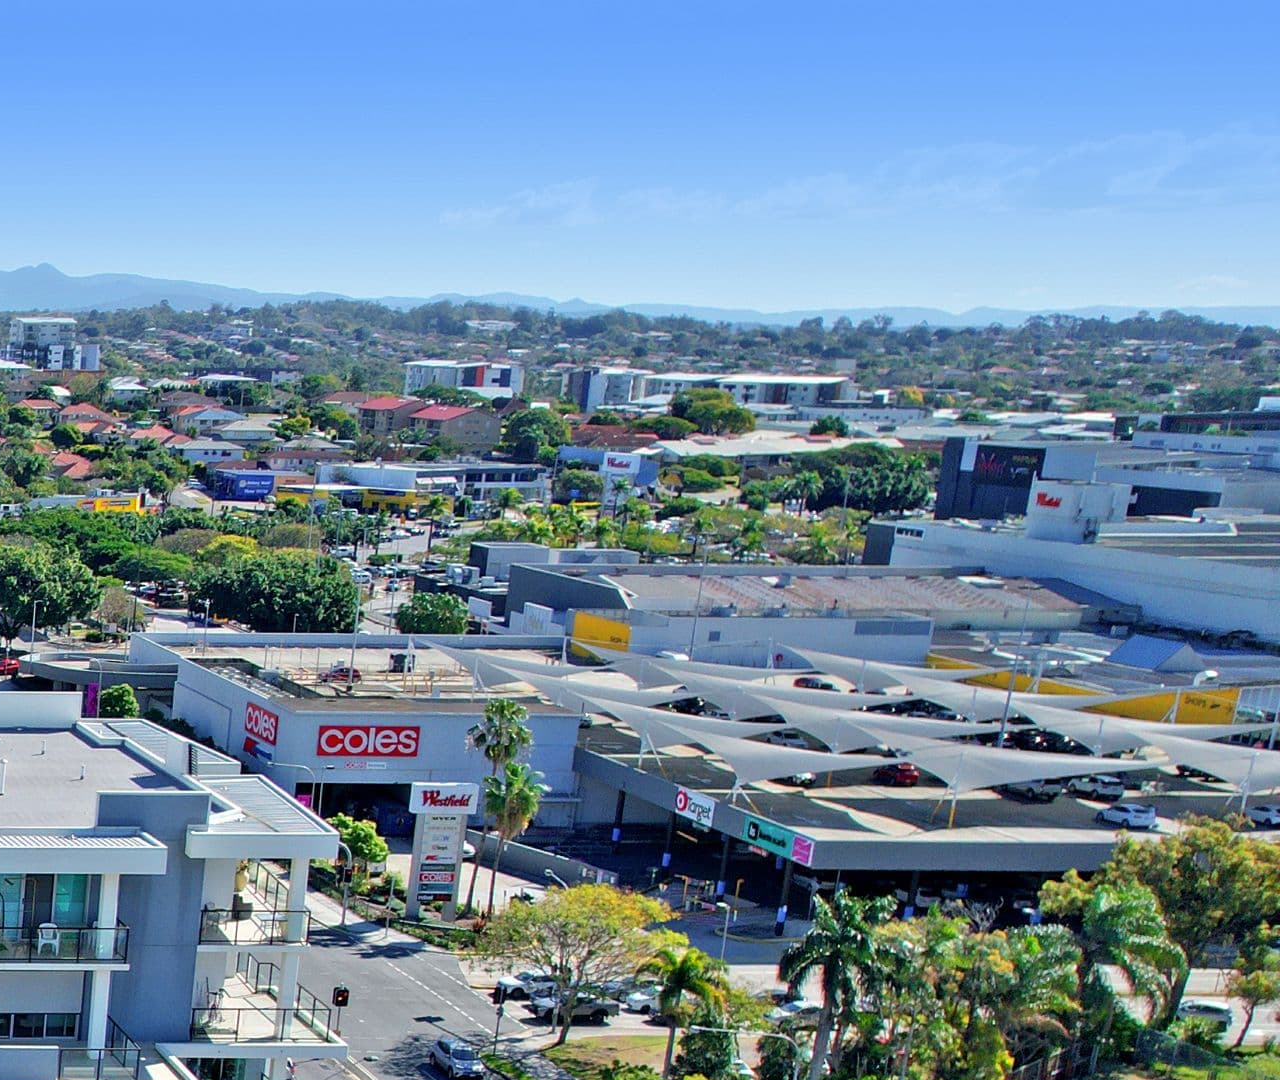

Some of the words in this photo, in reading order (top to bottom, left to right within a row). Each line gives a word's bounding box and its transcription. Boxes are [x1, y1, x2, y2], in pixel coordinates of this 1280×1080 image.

[246, 706, 276, 741] coles
[320, 727, 418, 754] coles
[422, 790, 472, 807] Westfield
[688, 796, 711, 821] Target
